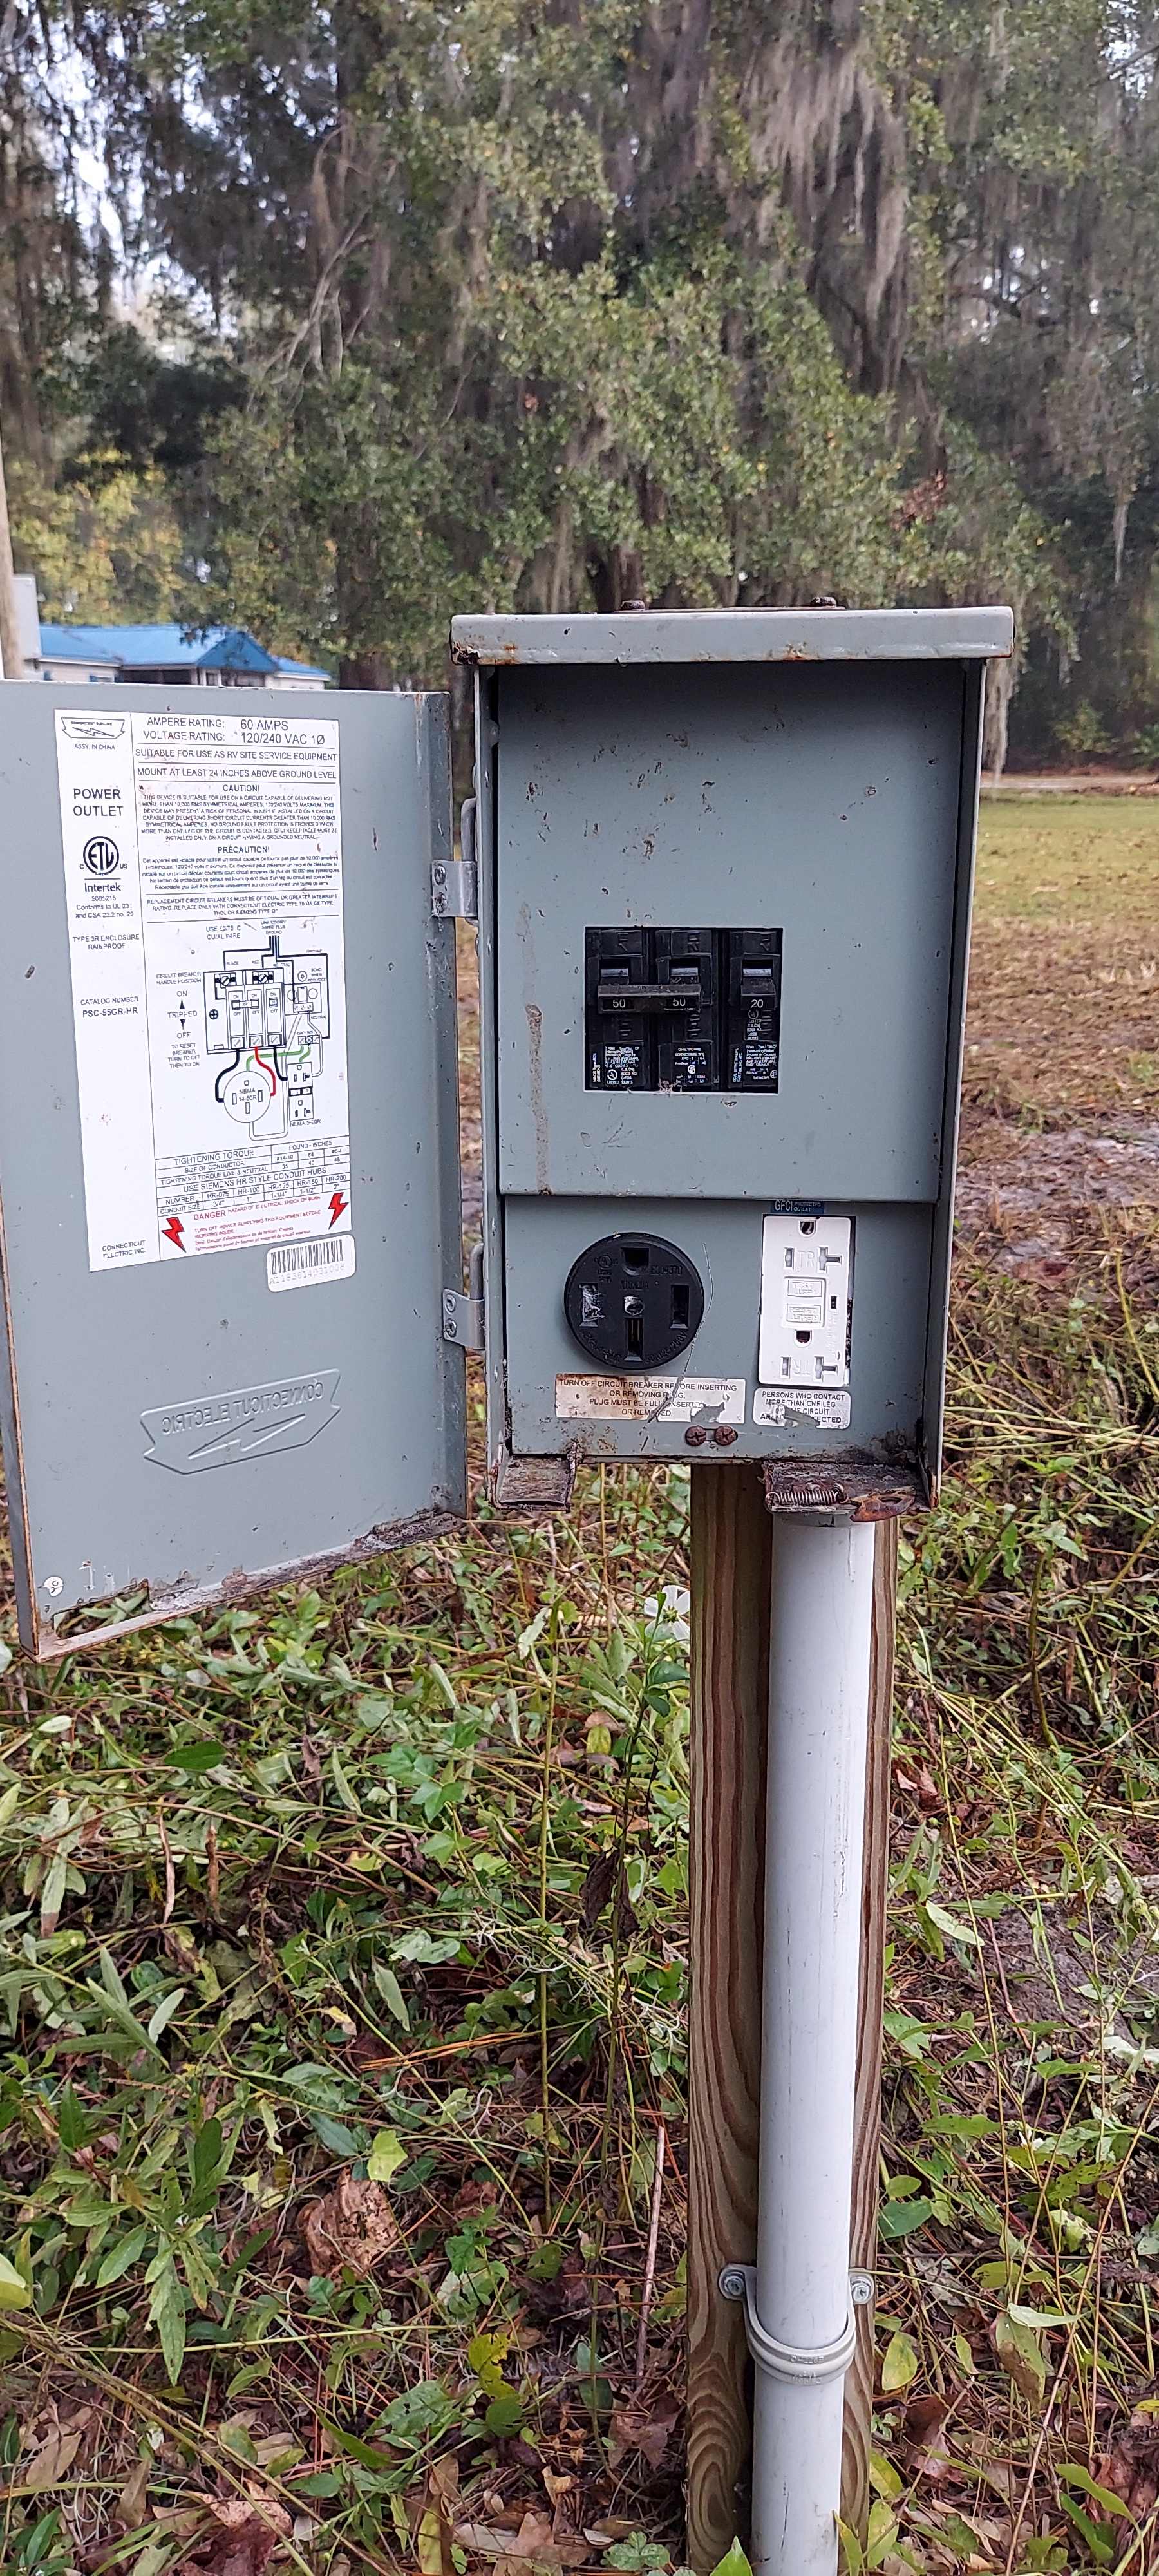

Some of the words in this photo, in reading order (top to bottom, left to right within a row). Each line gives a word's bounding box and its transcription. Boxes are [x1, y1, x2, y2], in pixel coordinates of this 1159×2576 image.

[147, 717, 186, 726] AMPERE
[189, 719, 224, 728] RATING:
[241, 719, 253, 729] 60
[257, 720, 288, 730] AMPS
[144, 730, 187, 740] VOLTAGE
[190, 732, 225, 741] RATING:
[241, 732, 281, 743] 120/240
[285, 734, 306, 744] VAC
[73, 788, 121, 799] POWER
[73, 806, 123, 816] OUTLET
[218, 844, 270, 853] PRÉCAUTION!
[85, 882, 121, 892] Intertek
[613, 999, 626, 1008] 50
[672, 998, 686, 1006] 50
[751, 999, 764, 1008] 20
[83, 1007, 138, 1018] PSC-55GR-HR
[175, 1154, 220, 1165] TIGHTENING
[223, 1149, 254, 1159] TORQUE
[209, 1160, 244, 1170] CONDUCTOR
[161, 1176, 196, 1185] TIGHTENING
[184, 1184, 199, 1193] USE
[201, 1179, 234, 1190] SIEMENS
[249, 1175, 271, 1184] STYLE
[274, 1170, 304, 1180] CONDUIT
[166, 1196, 194, 1205] NUMBER
[775, 1200, 793, 1211] GFCI
[160, 1206, 185, 1214] CONDUIT
[194, 1210, 226, 1220] DANGER
[102, 1240, 146, 1251] CONNECTICUT
[103, 1250, 133, 1259] ELECTRIC
[797, 1251, 815, 1268] TR
